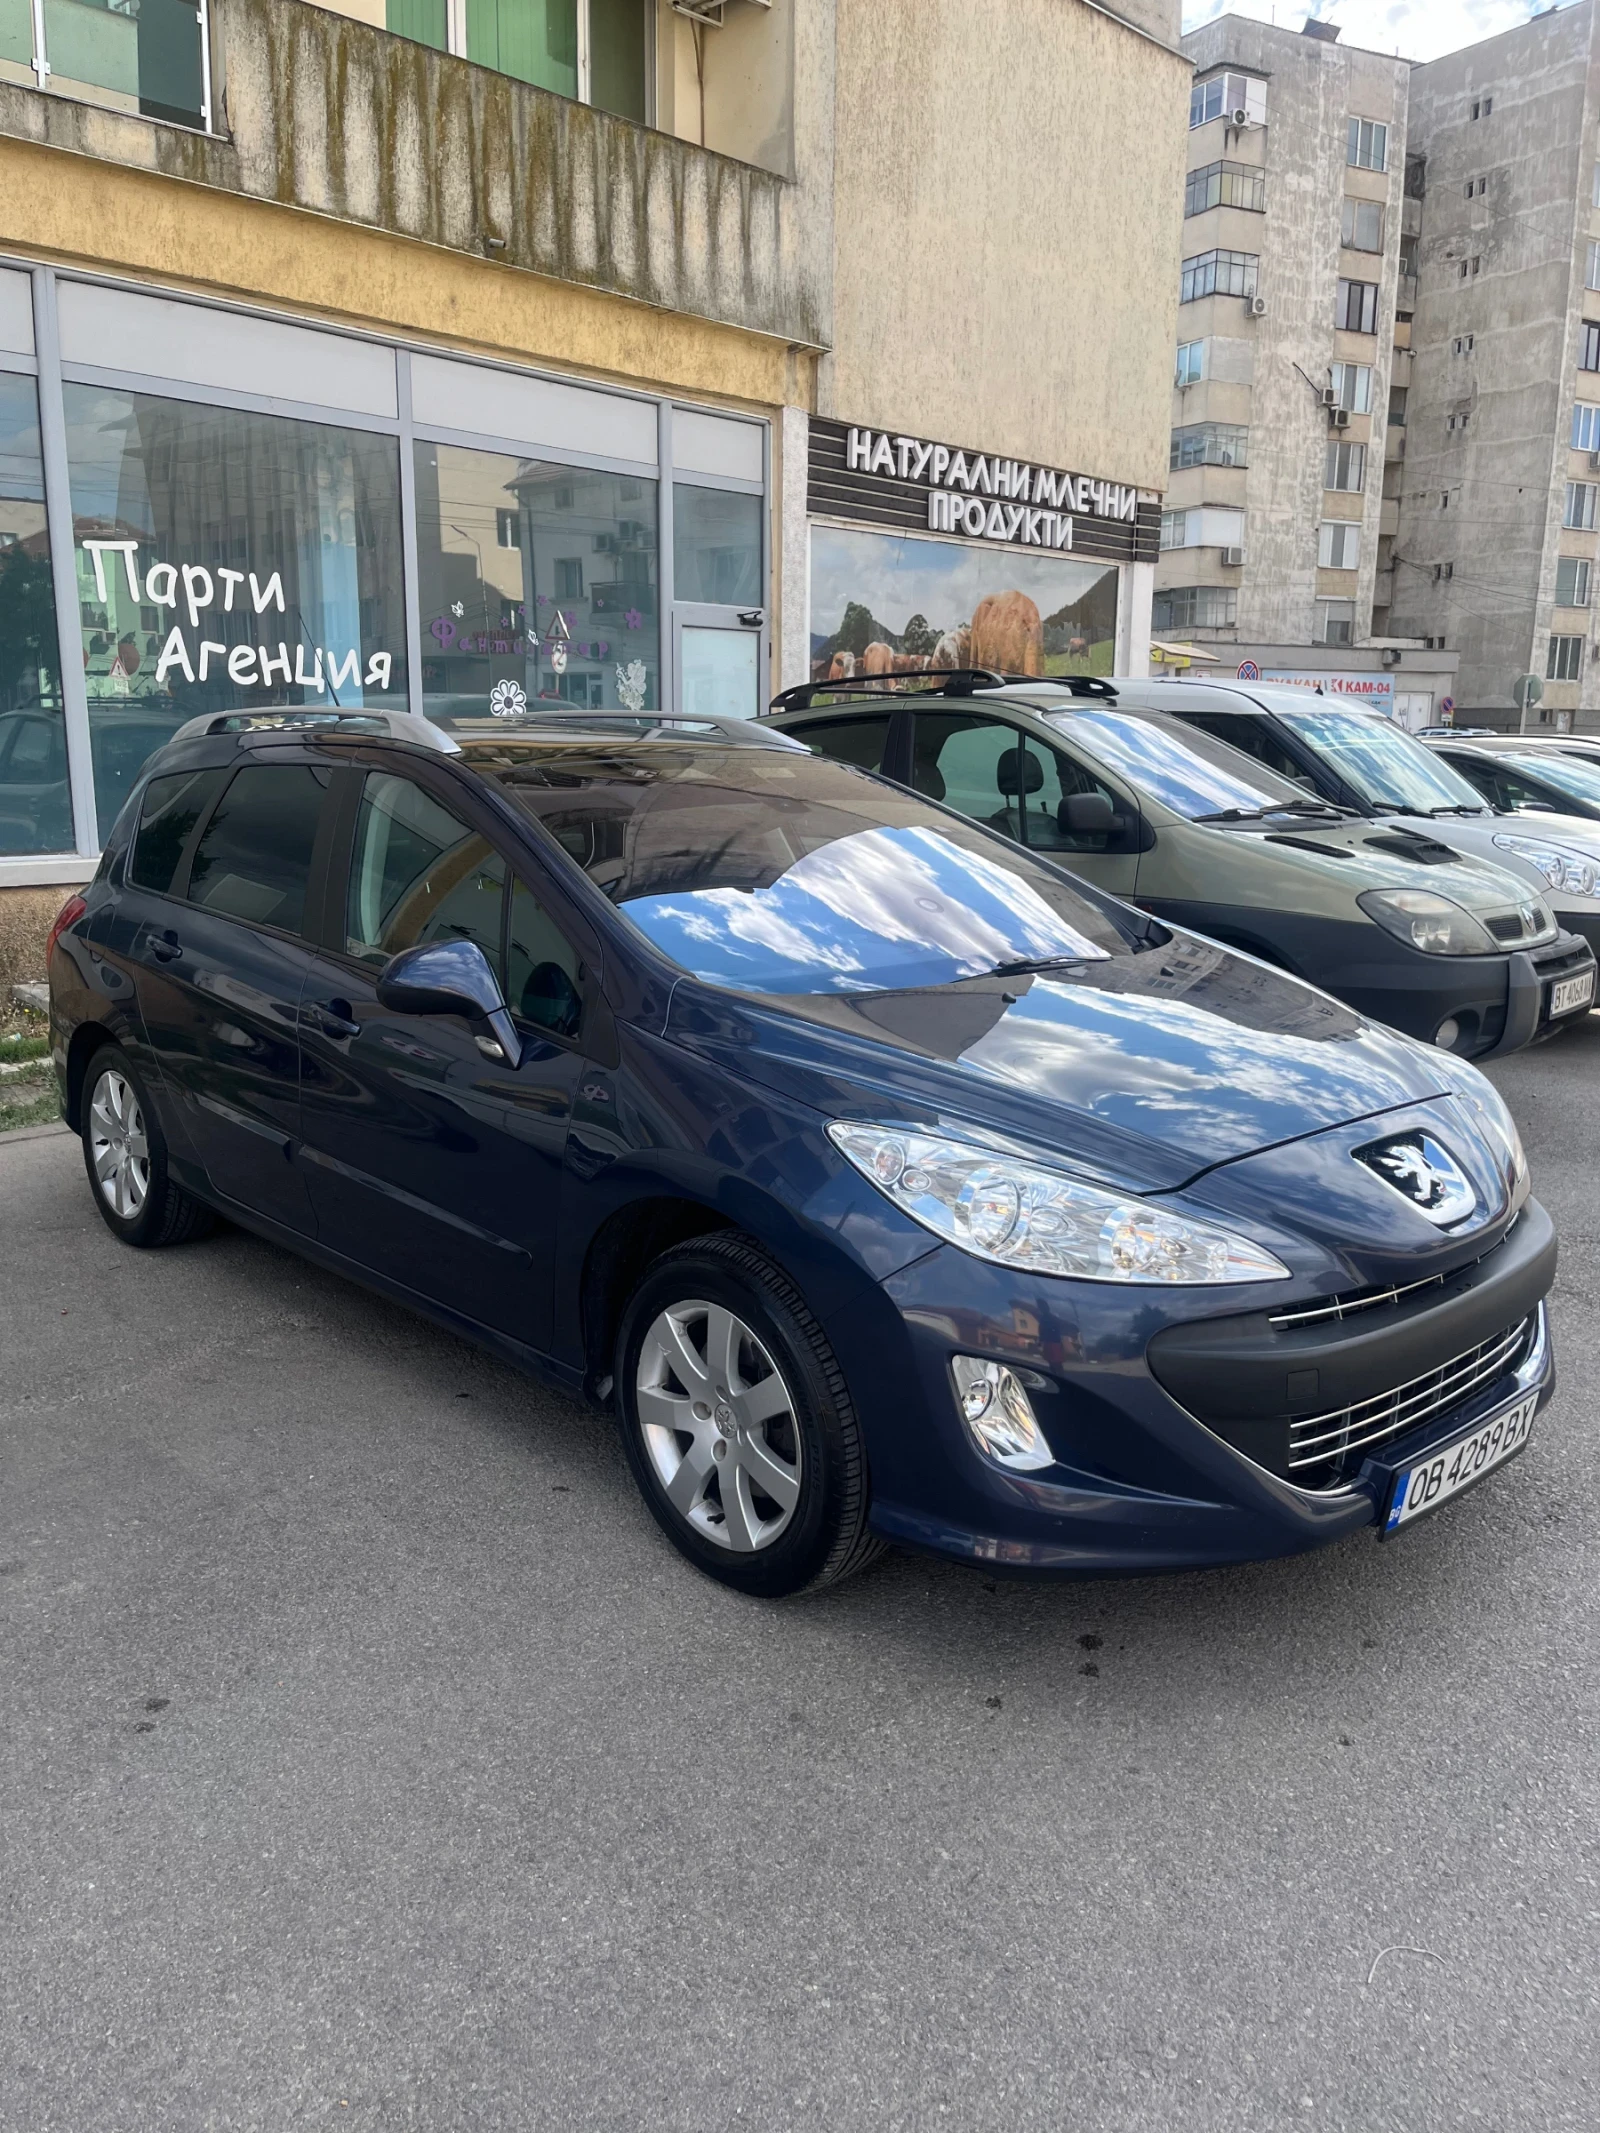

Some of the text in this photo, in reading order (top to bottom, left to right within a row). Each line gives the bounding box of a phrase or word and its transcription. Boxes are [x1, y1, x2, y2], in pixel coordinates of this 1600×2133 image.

[846, 427, 1136, 522] НАТУРАЛНИ МЛЕЧНИ
[928, 491, 1073, 550] ПРОДУКТИ
[82, 539, 286, 629] Парти
[155, 625, 392, 694] Агенция
[1388, 1398, 1535, 1522] BG OB 4289 BX
